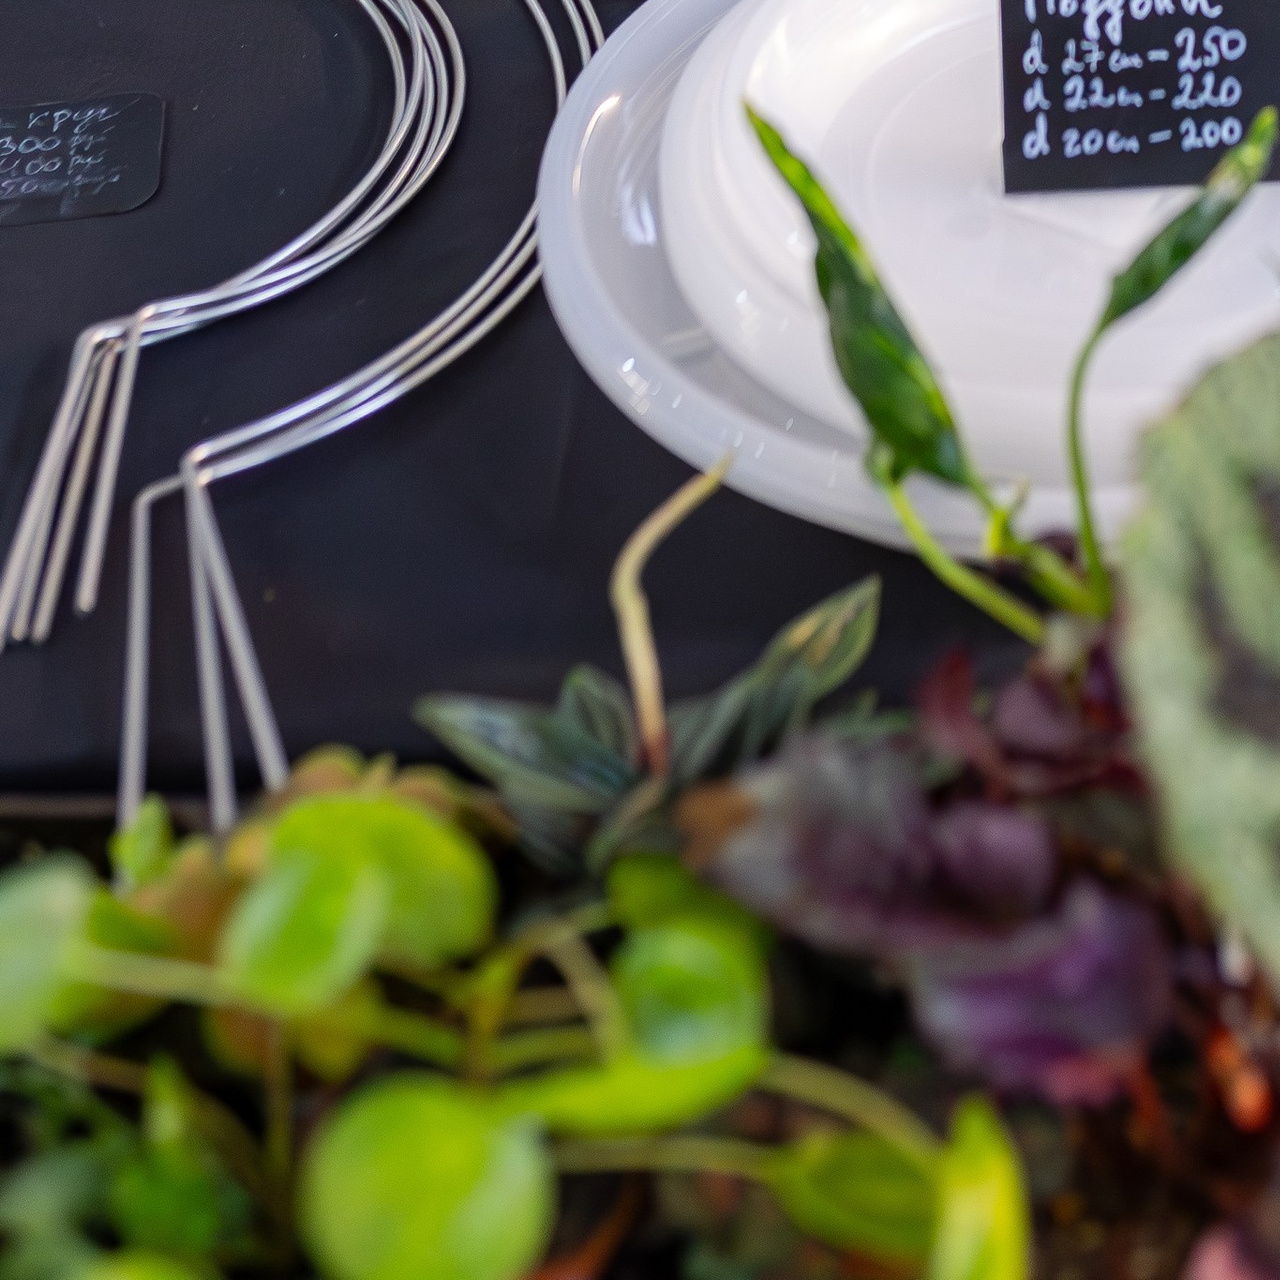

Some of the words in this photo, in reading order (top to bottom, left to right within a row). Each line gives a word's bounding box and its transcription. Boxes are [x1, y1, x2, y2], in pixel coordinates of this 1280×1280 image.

[1175, 25, 1246, 72] 250
[1172, 71, 1242, 110] 220
[1179, 115, 1243, 152] 200
